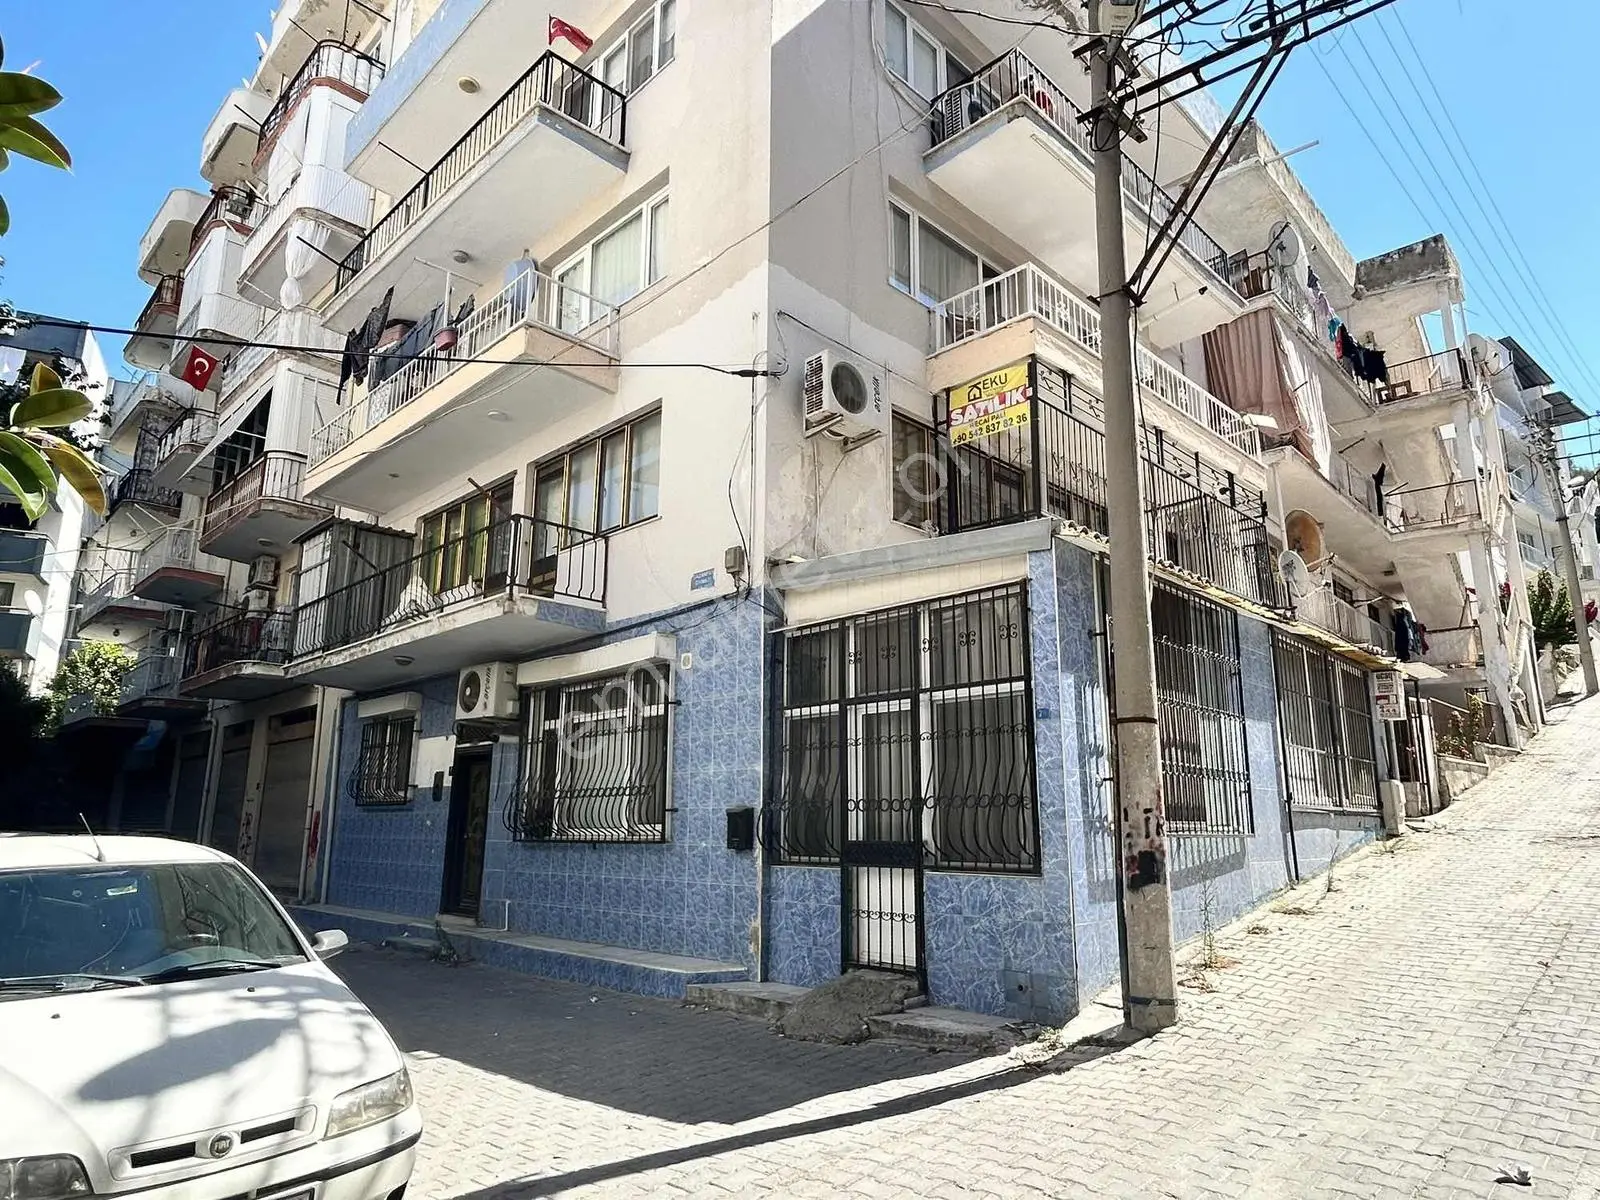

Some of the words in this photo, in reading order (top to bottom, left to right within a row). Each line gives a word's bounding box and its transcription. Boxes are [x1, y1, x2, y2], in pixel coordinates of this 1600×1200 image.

[982, 373, 1008, 390] EKU
[950, 386, 1027, 426] SATILIK
[953, 432, 967, 444] +90
[968, 428, 983, 440] 542
[985, 421, 1001, 434] 837
[1003, 417, 1014, 428] 82
[1016, 413, 1028, 424] 36
